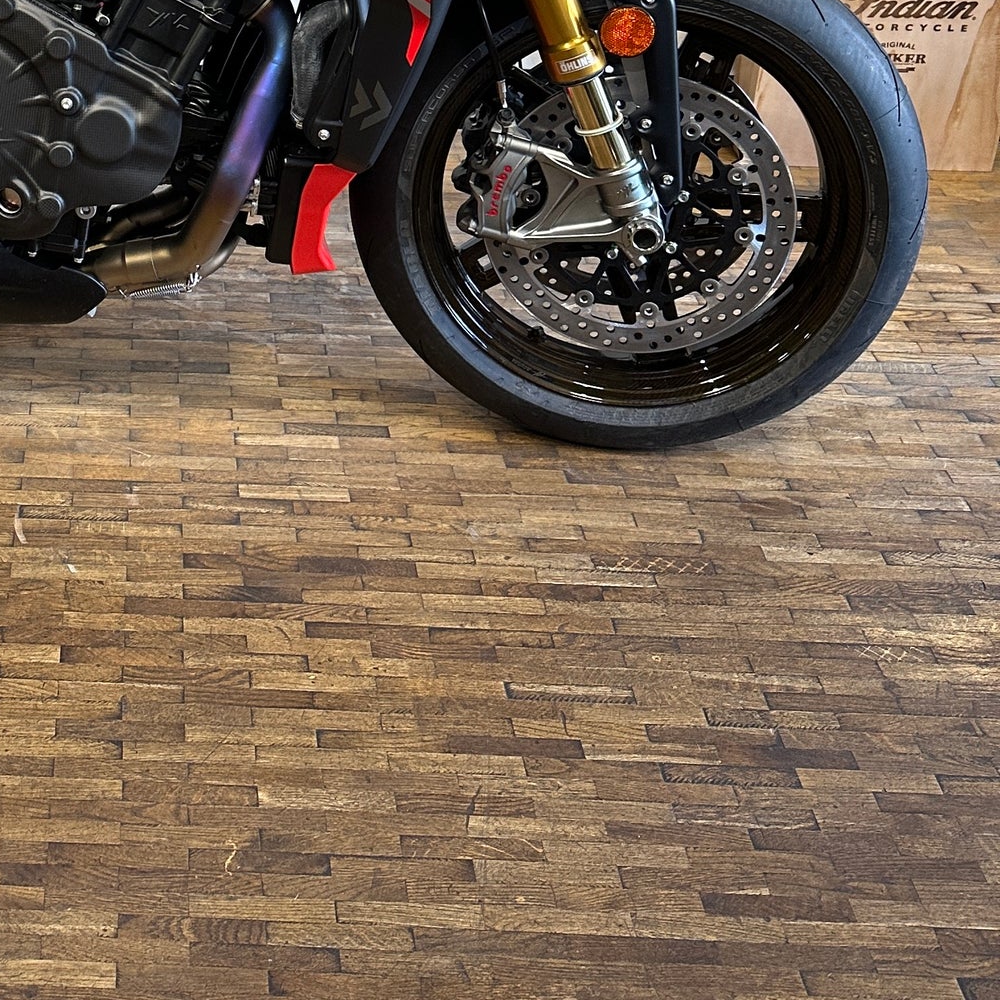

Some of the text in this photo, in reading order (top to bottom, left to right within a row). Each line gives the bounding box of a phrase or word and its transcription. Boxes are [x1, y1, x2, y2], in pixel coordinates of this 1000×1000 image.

[864, 23, 969, 32] ORCYCLE
[880, 41, 916, 51] RIGINAL
[485, 164, 512, 217] brembo
